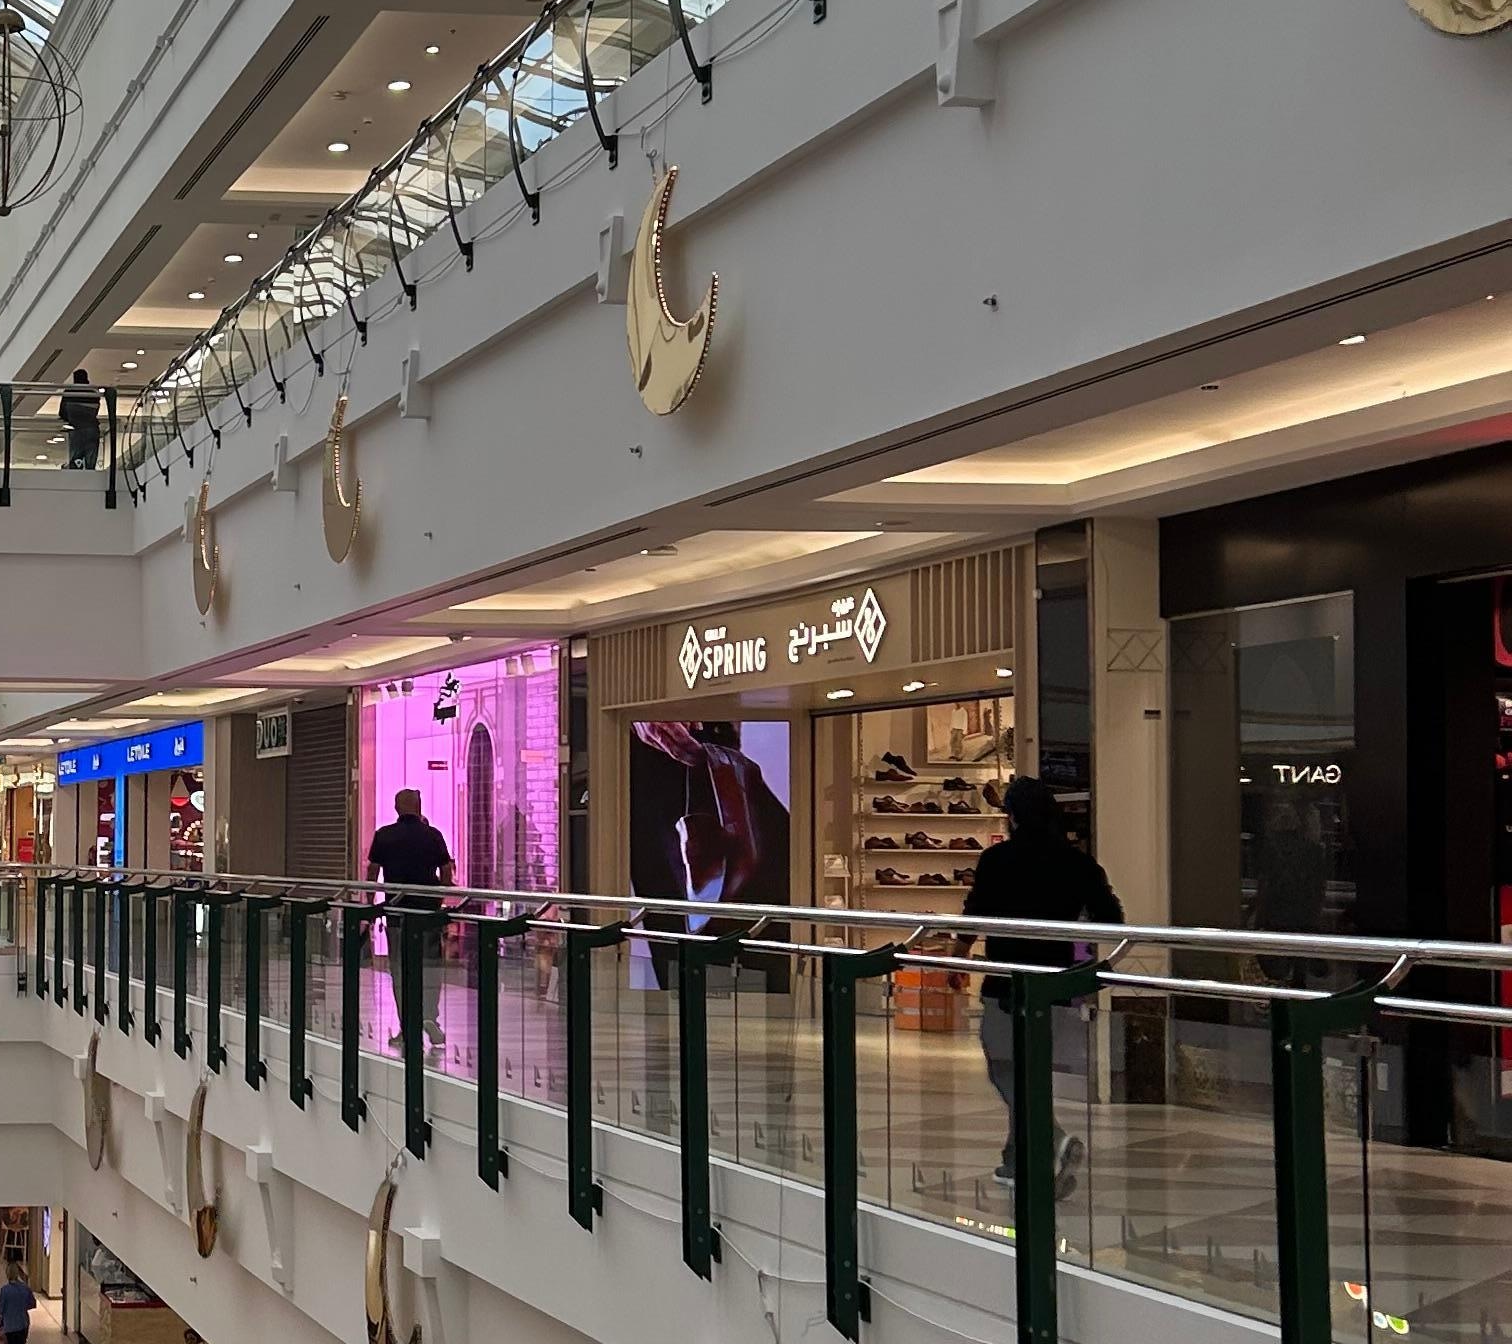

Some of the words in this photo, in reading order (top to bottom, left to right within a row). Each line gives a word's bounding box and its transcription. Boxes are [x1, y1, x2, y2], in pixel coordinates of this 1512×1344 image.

[703, 637, 767, 679] SPRING
[788, 619, 853, 663] سبرنج
[256, 717, 277, 749] DUO
